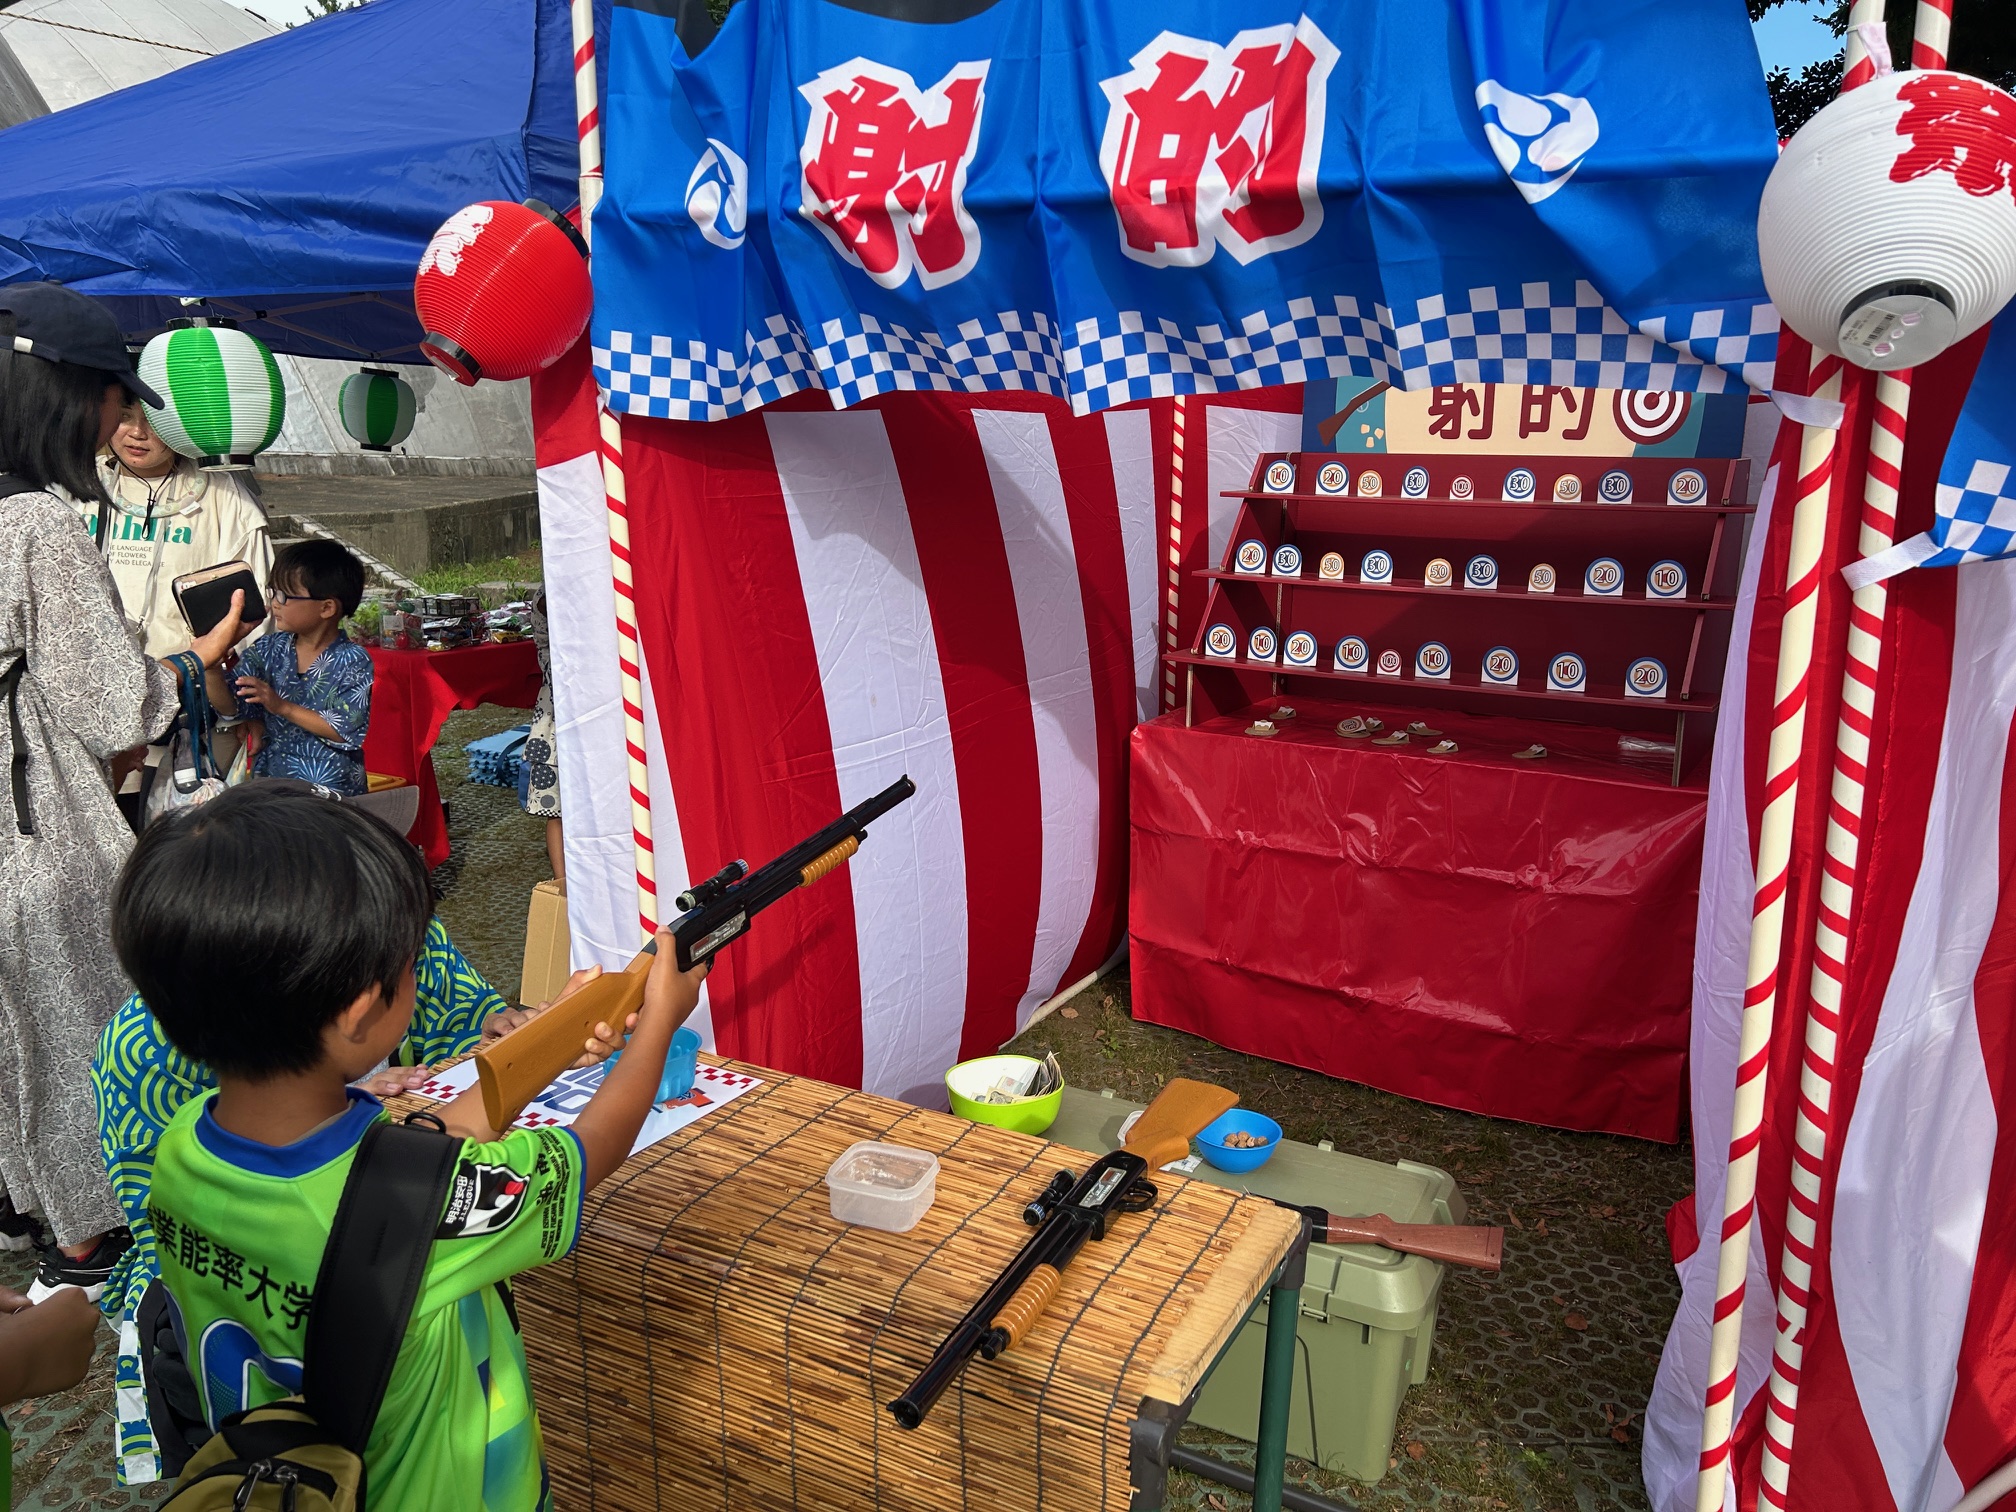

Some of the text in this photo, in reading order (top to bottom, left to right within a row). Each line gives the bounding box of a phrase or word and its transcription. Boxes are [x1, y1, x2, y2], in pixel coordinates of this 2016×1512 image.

[799, 13, 1341, 290] 射的
[1428, 383, 1596, 440] 射的
[1272, 468, 1288, 483] 10
[1323, 470, 1342, 484] 20
[1408, 474, 1424, 488] 30
[1362, 477, 1377, 489] 50
[1454, 482, 1471, 492] 100
[1511, 477, 1529, 491] 30
[1560, 482, 1577, 493] 50
[1605, 478, 1625, 492] 30
[1676, 478, 1699, 494] 20
[1242, 549, 1259, 562] 20
[1279, 552, 1296, 566] 30
[1324, 560, 1339, 572] 50
[1368, 559, 1386, 572] 30
[1431, 565, 1447, 578] 50
[1472, 563, 1492, 577] 30
[1534, 571, 1551, 583] 50
[1594, 568, 1616, 583] 20
[1656, 570, 1677, 586] 10
[1212, 632, 1229, 646] 20
[1255, 635, 1270, 649] 10
[1291, 641, 1309, 654] 20
[1343, 645, 1361, 659] 10
[1382, 655, 1398, 666] 100
[1424, 651, 1443, 666] 10
[1490, 657, 1511, 671] 20
[1557, 662, 1578, 678] 10
[1635, 669, 1657, 684] 20
[445, 1174, 468, 1224] 明治安田
